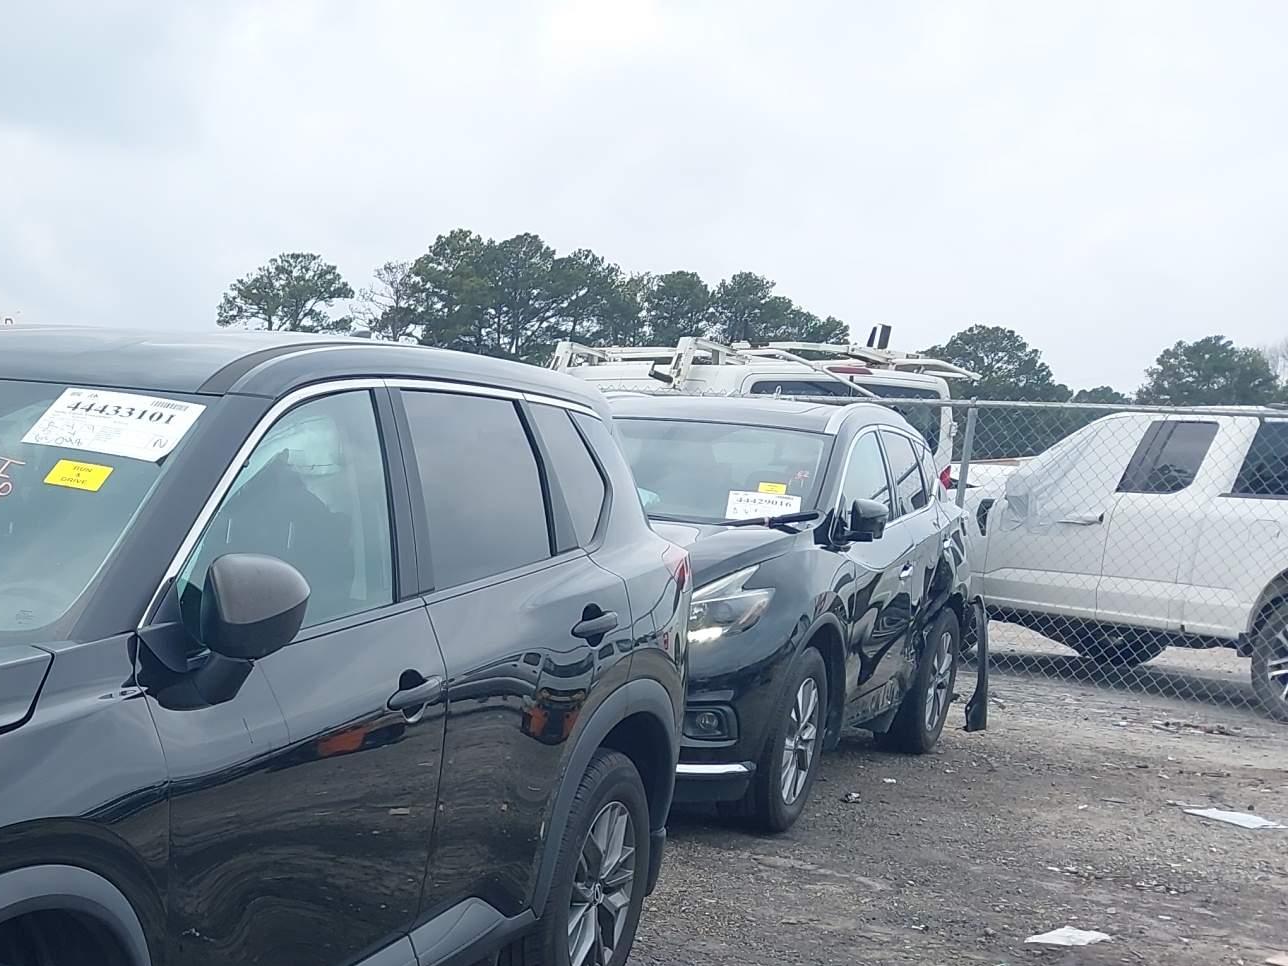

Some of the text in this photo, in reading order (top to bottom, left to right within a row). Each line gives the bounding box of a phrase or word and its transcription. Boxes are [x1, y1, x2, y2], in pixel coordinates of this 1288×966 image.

[66, 401, 177, 425] 44433101
[72, 465, 94, 473] RUN
[59, 476, 88, 485] DRIVE
